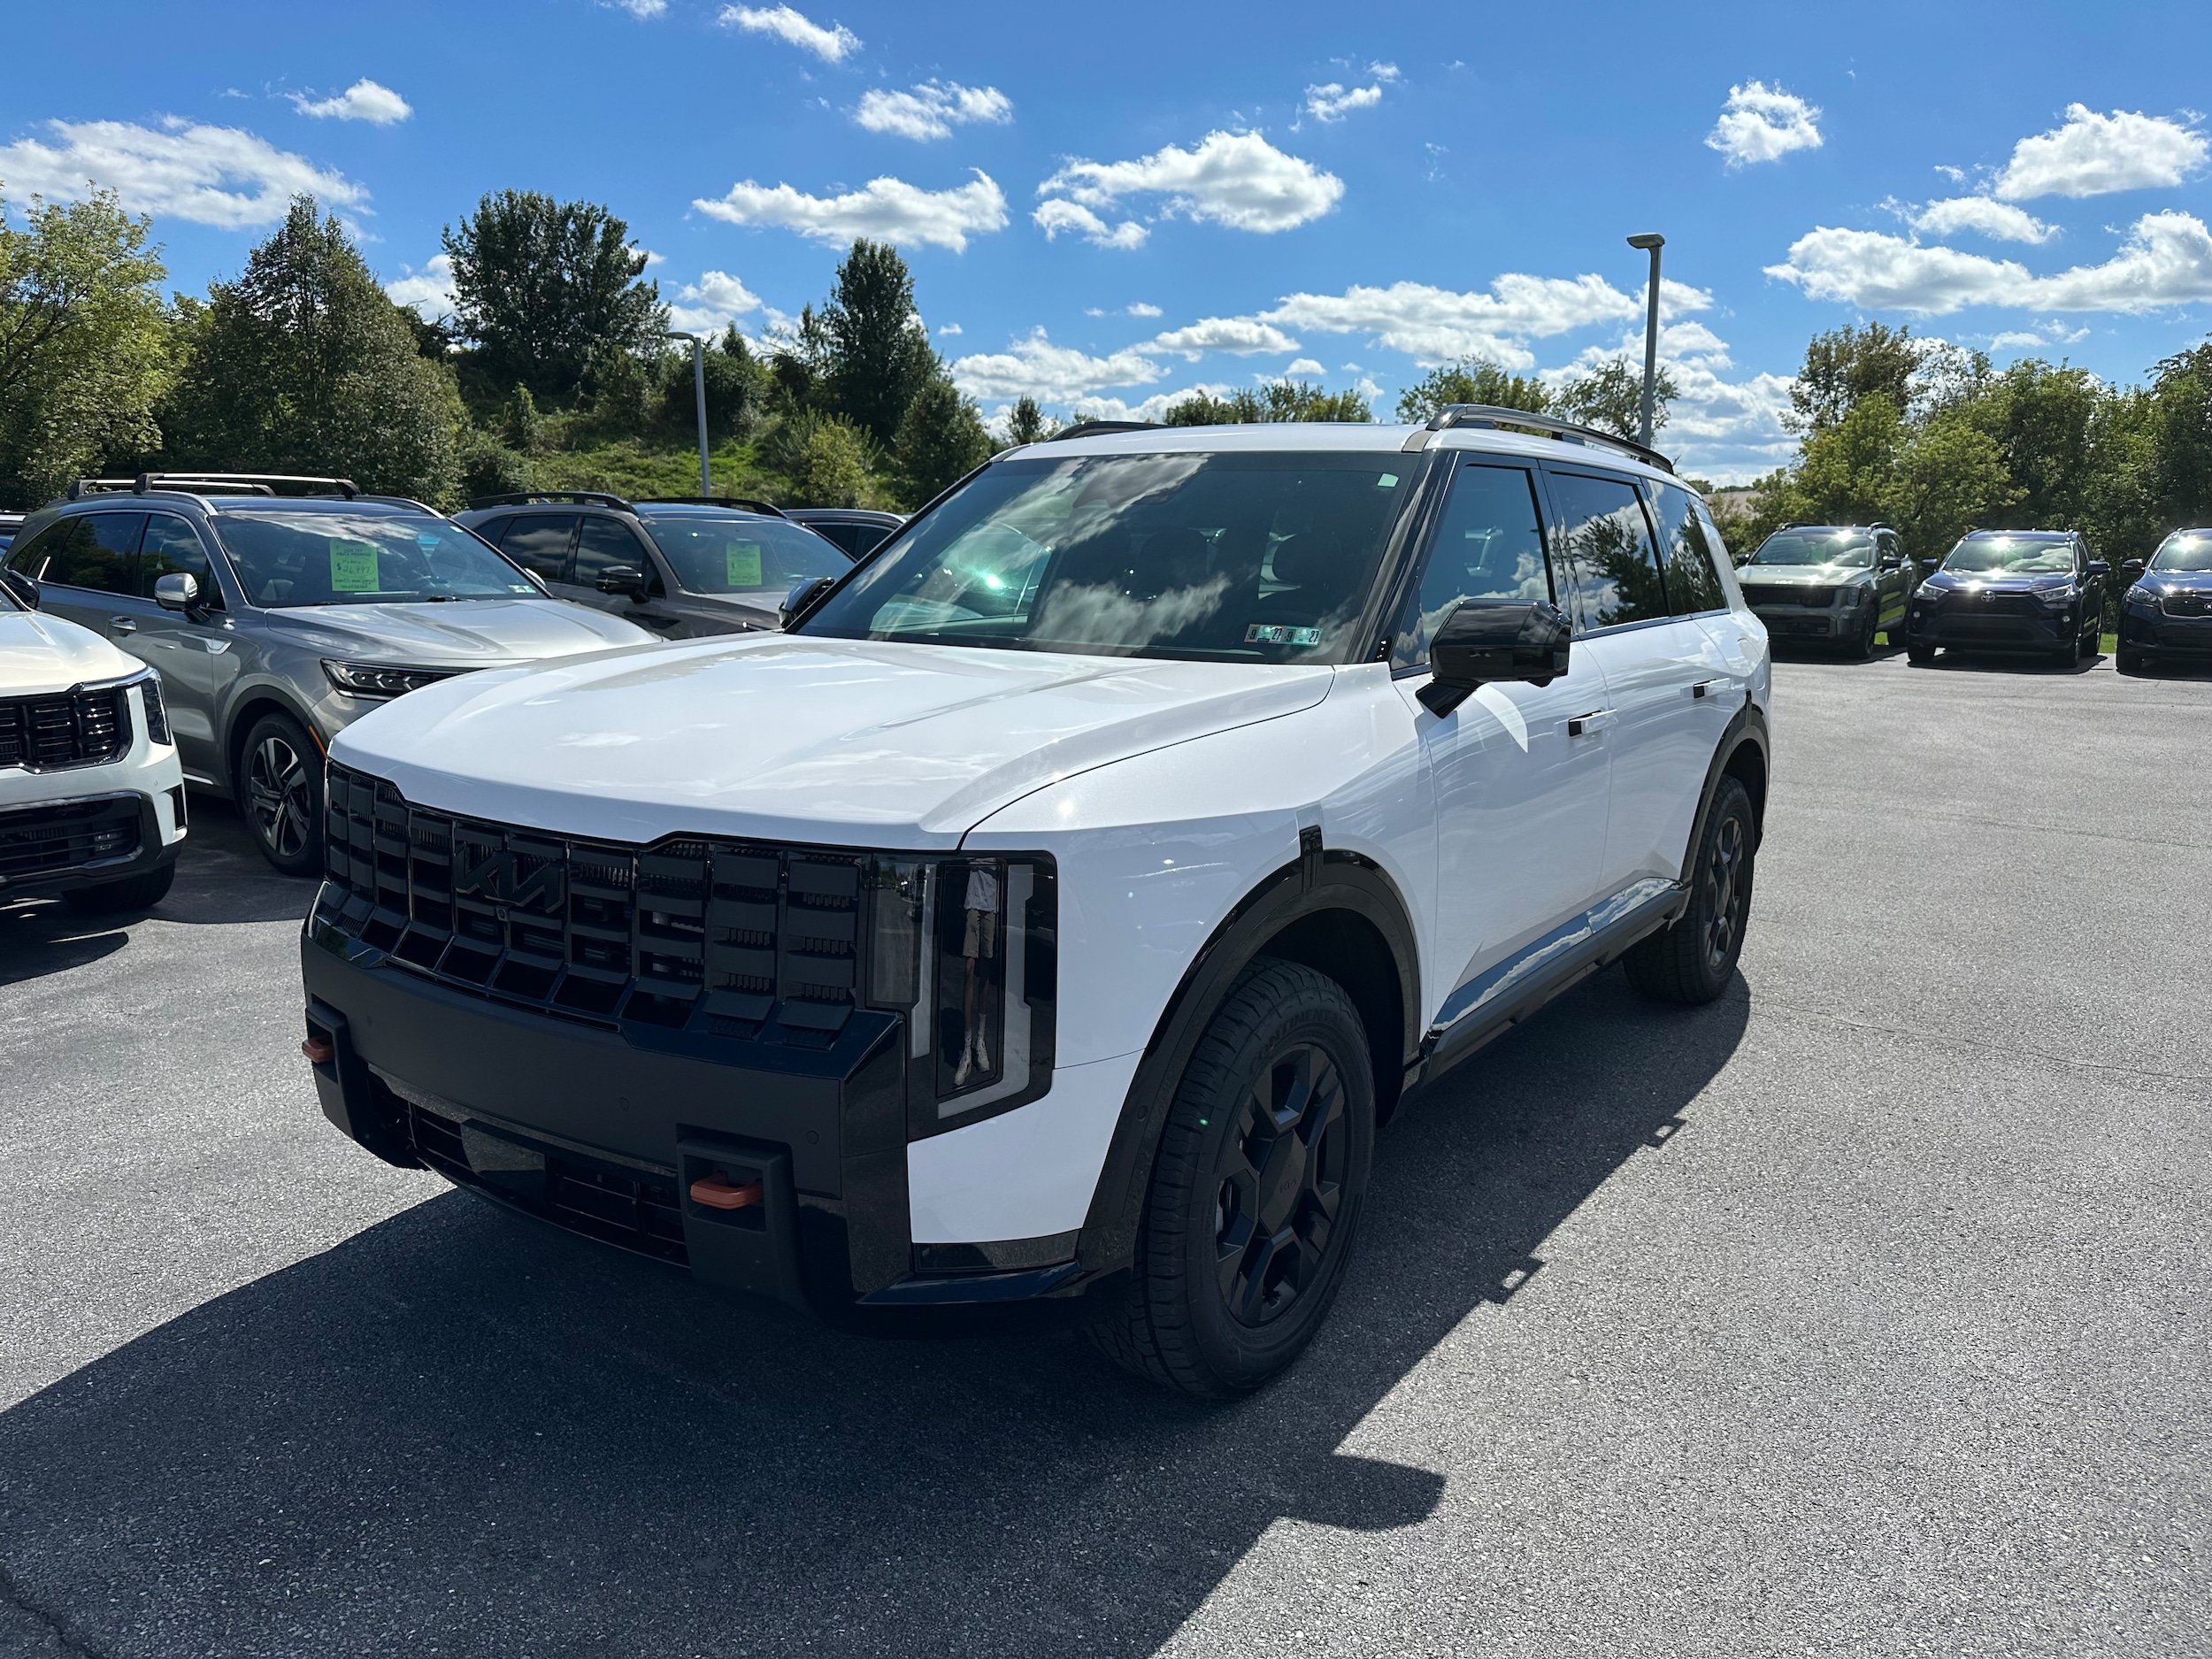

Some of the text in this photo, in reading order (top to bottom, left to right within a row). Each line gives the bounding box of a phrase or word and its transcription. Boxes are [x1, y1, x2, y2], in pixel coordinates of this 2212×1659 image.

[1271, 627, 1283, 641] 27
[1309, 631, 1319, 642] 27
[452, 841, 566, 914] KIA
